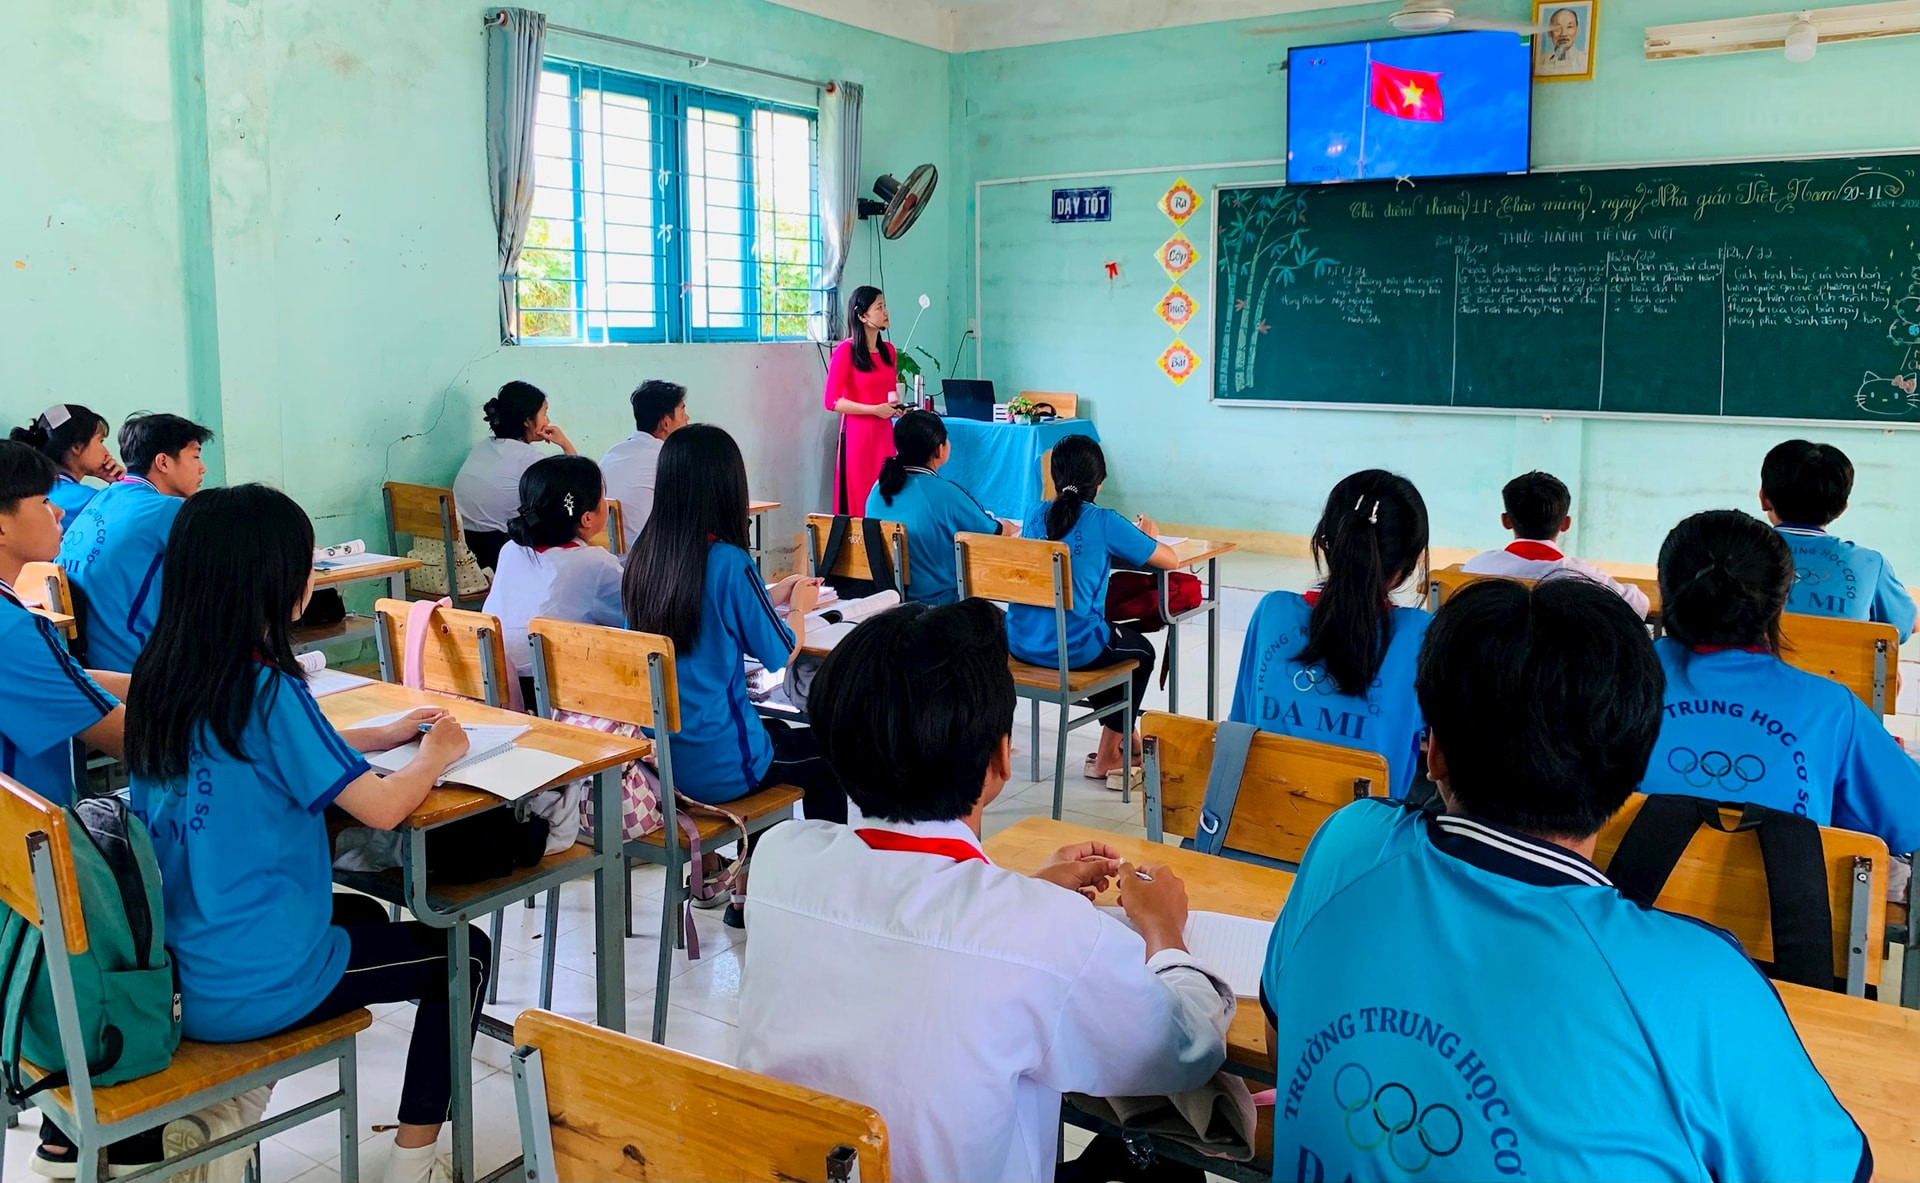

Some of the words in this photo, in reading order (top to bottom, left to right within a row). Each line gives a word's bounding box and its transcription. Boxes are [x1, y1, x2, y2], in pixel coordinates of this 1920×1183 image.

[1057, 197, 1080, 219] DẠY
[1084, 191, 1107, 214] TỐT
[1174, 196, 1188, 209] Ra
[1694, 186, 1731, 221] giáo
[1808, 592, 1846, 614] MI
[1257, 632, 1289, 693] TRƯỜNG
[1262, 696, 1304, 727] ĐA
[1316, 706, 1369, 740] MI
[1664, 699, 1744, 719] TRUNG
[1750, 709, 1797, 747] HỌC
[1792, 750, 1809, 783] CƠ
[195, 767, 213, 797] CƠ
[1284, 1013, 1356, 1121] TRƯỜNG
[1359, 1006, 1462, 1060] TRUNG
[1454, 1048, 1512, 1123] HỌC
[1490, 1126, 1528, 1176] CƠ
